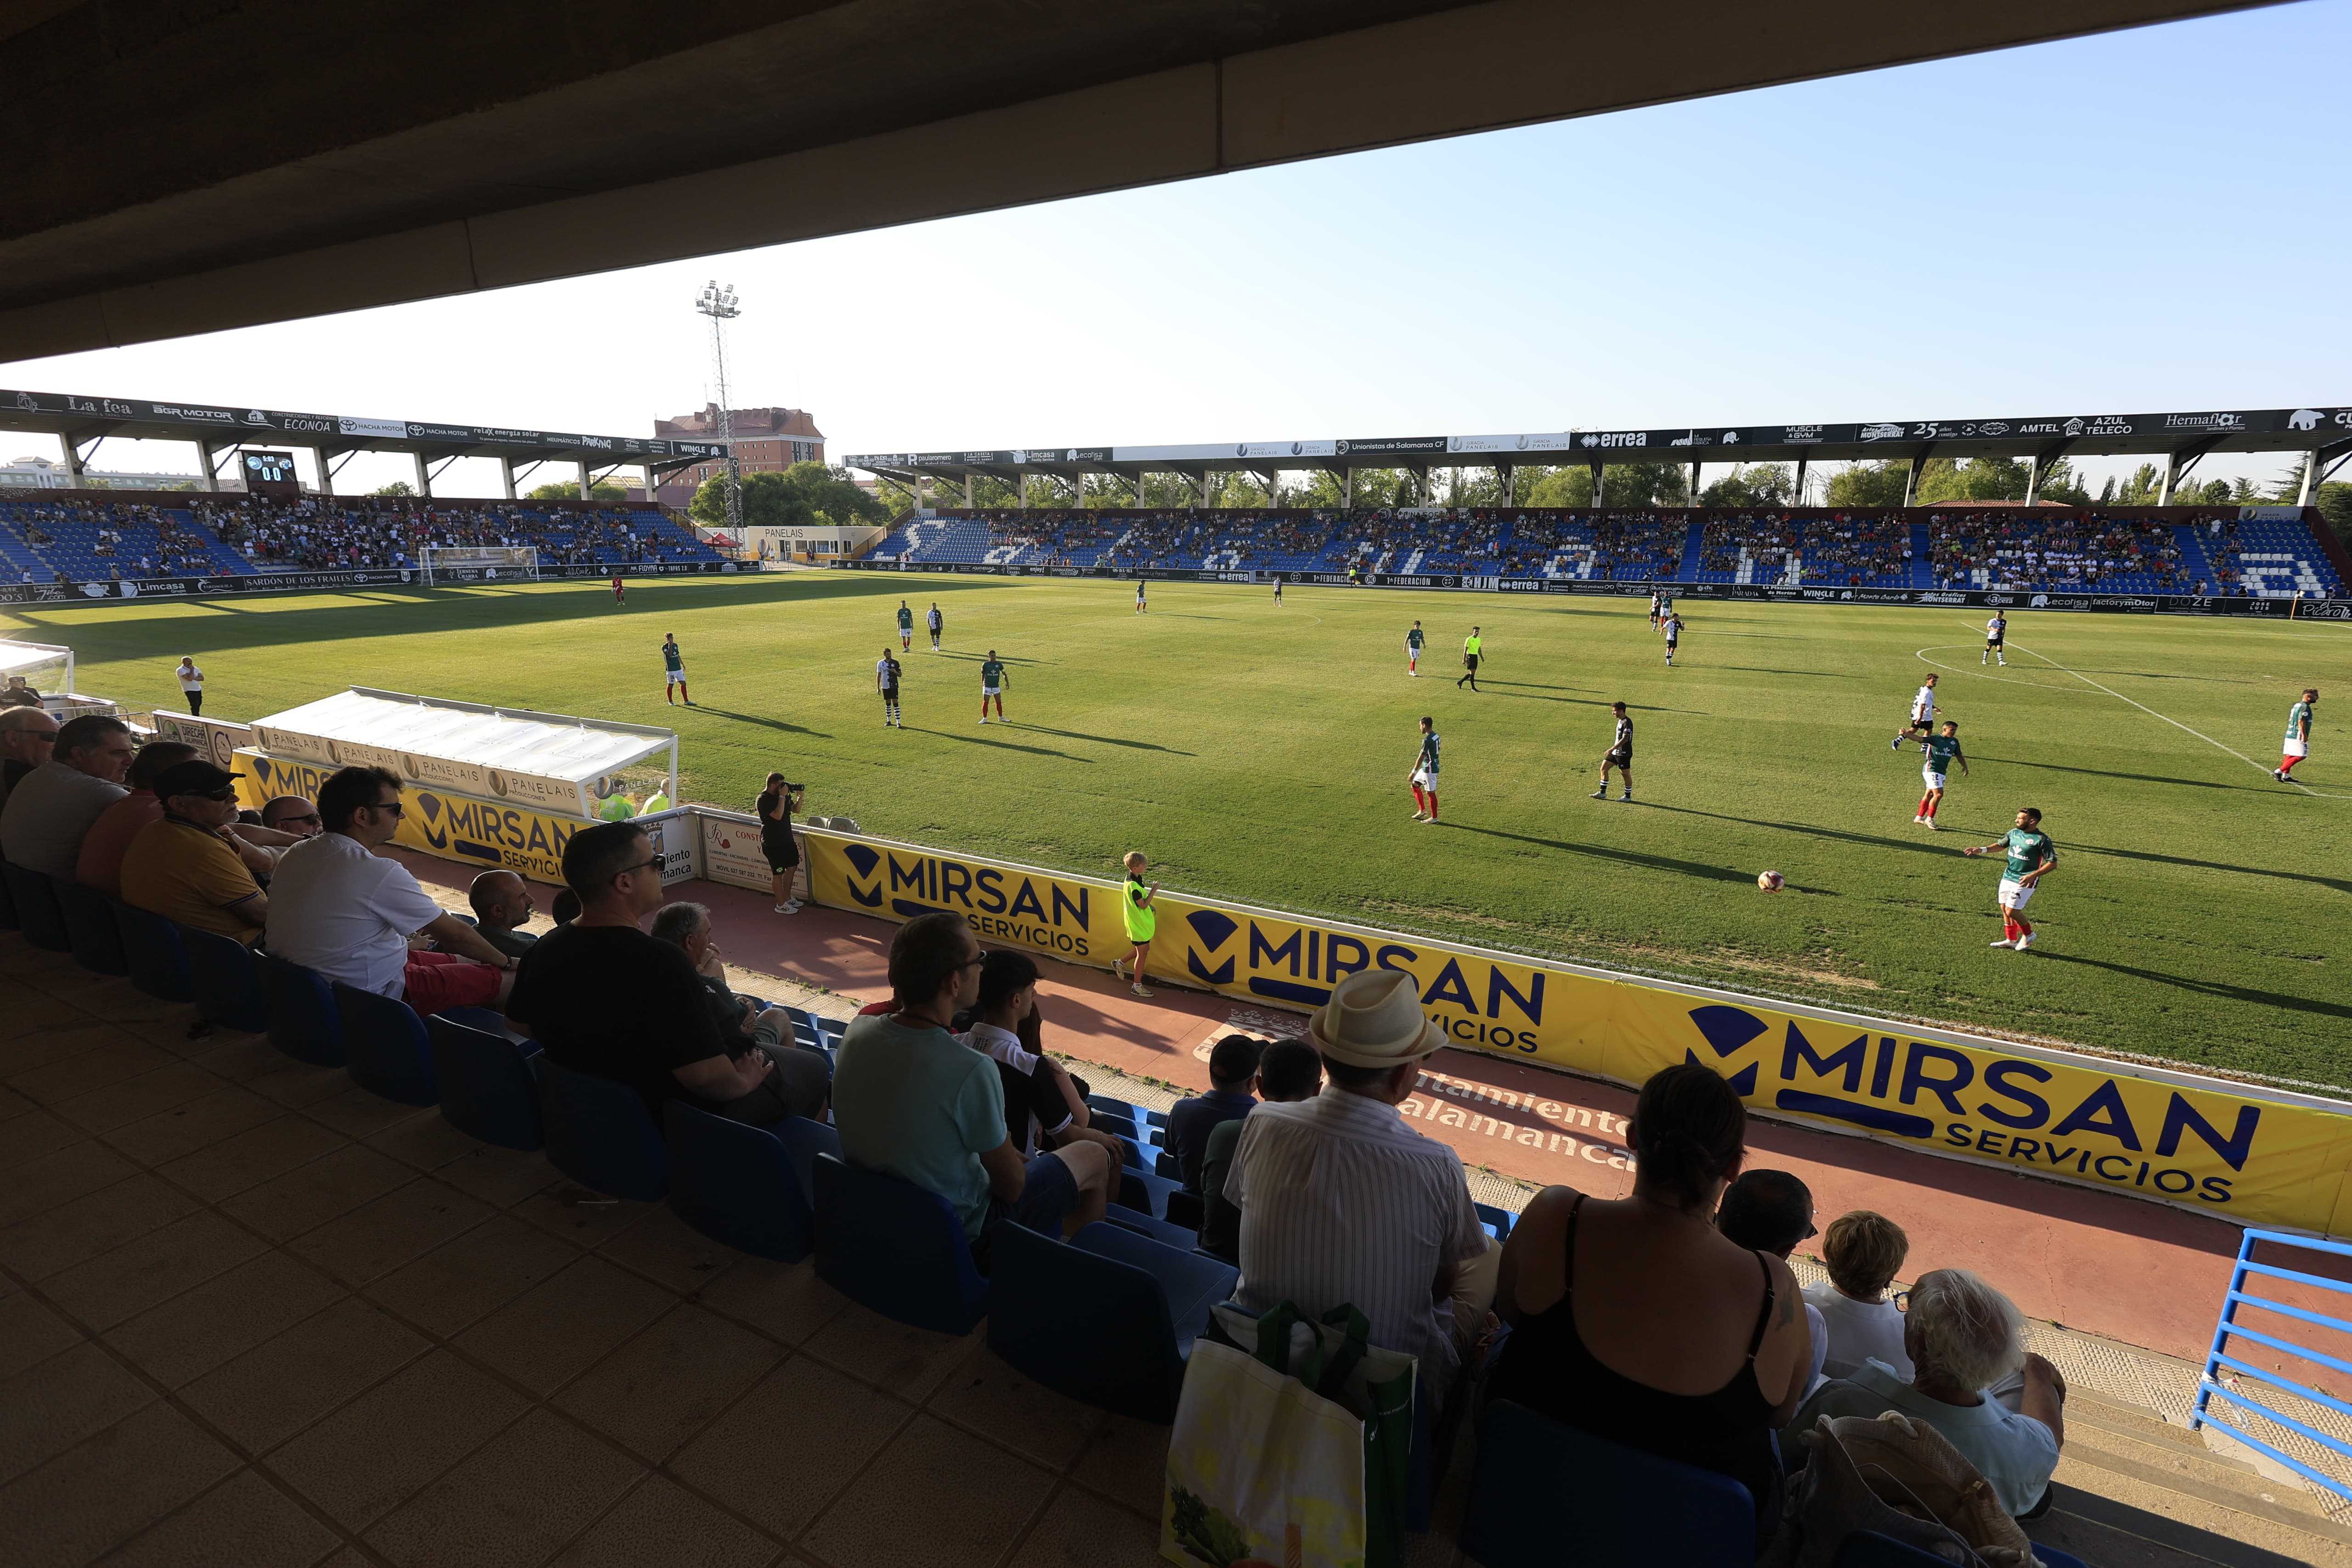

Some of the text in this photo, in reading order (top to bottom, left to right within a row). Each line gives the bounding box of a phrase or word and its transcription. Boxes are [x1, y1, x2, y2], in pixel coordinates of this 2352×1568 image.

[66, 396, 132, 414] La fea
[184, 410, 234, 420] MOTOR
[2094, 416, 2126, 425] AZUL
[2165, 413, 2242, 426] Hermaflor
[284, 419, 330, 431] ECONOA
[1913, 423, 1939, 439] 25
[2019, 424, 2059, 433] AMTEL
[2086, 425, 2132, 435] TELECO
[582, 436, 611, 449] PARKING
[1600, 432, 1647, 447] errea
[765, 529, 803, 538] PANELAIS
[246, 576, 283, 586] SARDÓN
[1227, 573, 1249, 581] errea
[1394, 577, 1431, 585] FEDERACIÓN
[1474, 577, 1496, 589] HJM
[137, 582, 185, 591] Limcasa
[1511, 581, 1539, 590] errea
[2169, 597, 2213, 606] DOZE
[2319, 600, 2330, 610] el
[2302, 604, 2341, 617] Pícaro
[182, 725, 205, 738] DIRECAR
[184, 736, 208, 747] SALAMANCA
[273, 734, 320, 750] PANELAIS
[271, 744, 300, 753] PRODUCCIONES
[343, 747, 394, 764] PANELAIS
[421, 772, 454, 783] PRODUCCIONES
[423, 762, 479, 781] PANELAIS
[512, 778, 576, 799] PANELAIS
[509, 789, 546, 802] PRODUCCIONES
[445, 798, 576, 858] MIRSAN
[503, 850, 562, 878] SERVICI
[716, 864, 730, 872] MÓVIL
[888, 851, 1089, 933] MIRSAN
[969, 913, 1089, 956] SERVICIOS
[1249, 919, 1545, 1027] MIRSAN
[1779, 1019, 2262, 1173] MIRSAN
[1944, 1122, 2233, 1204] SERVICIOS
